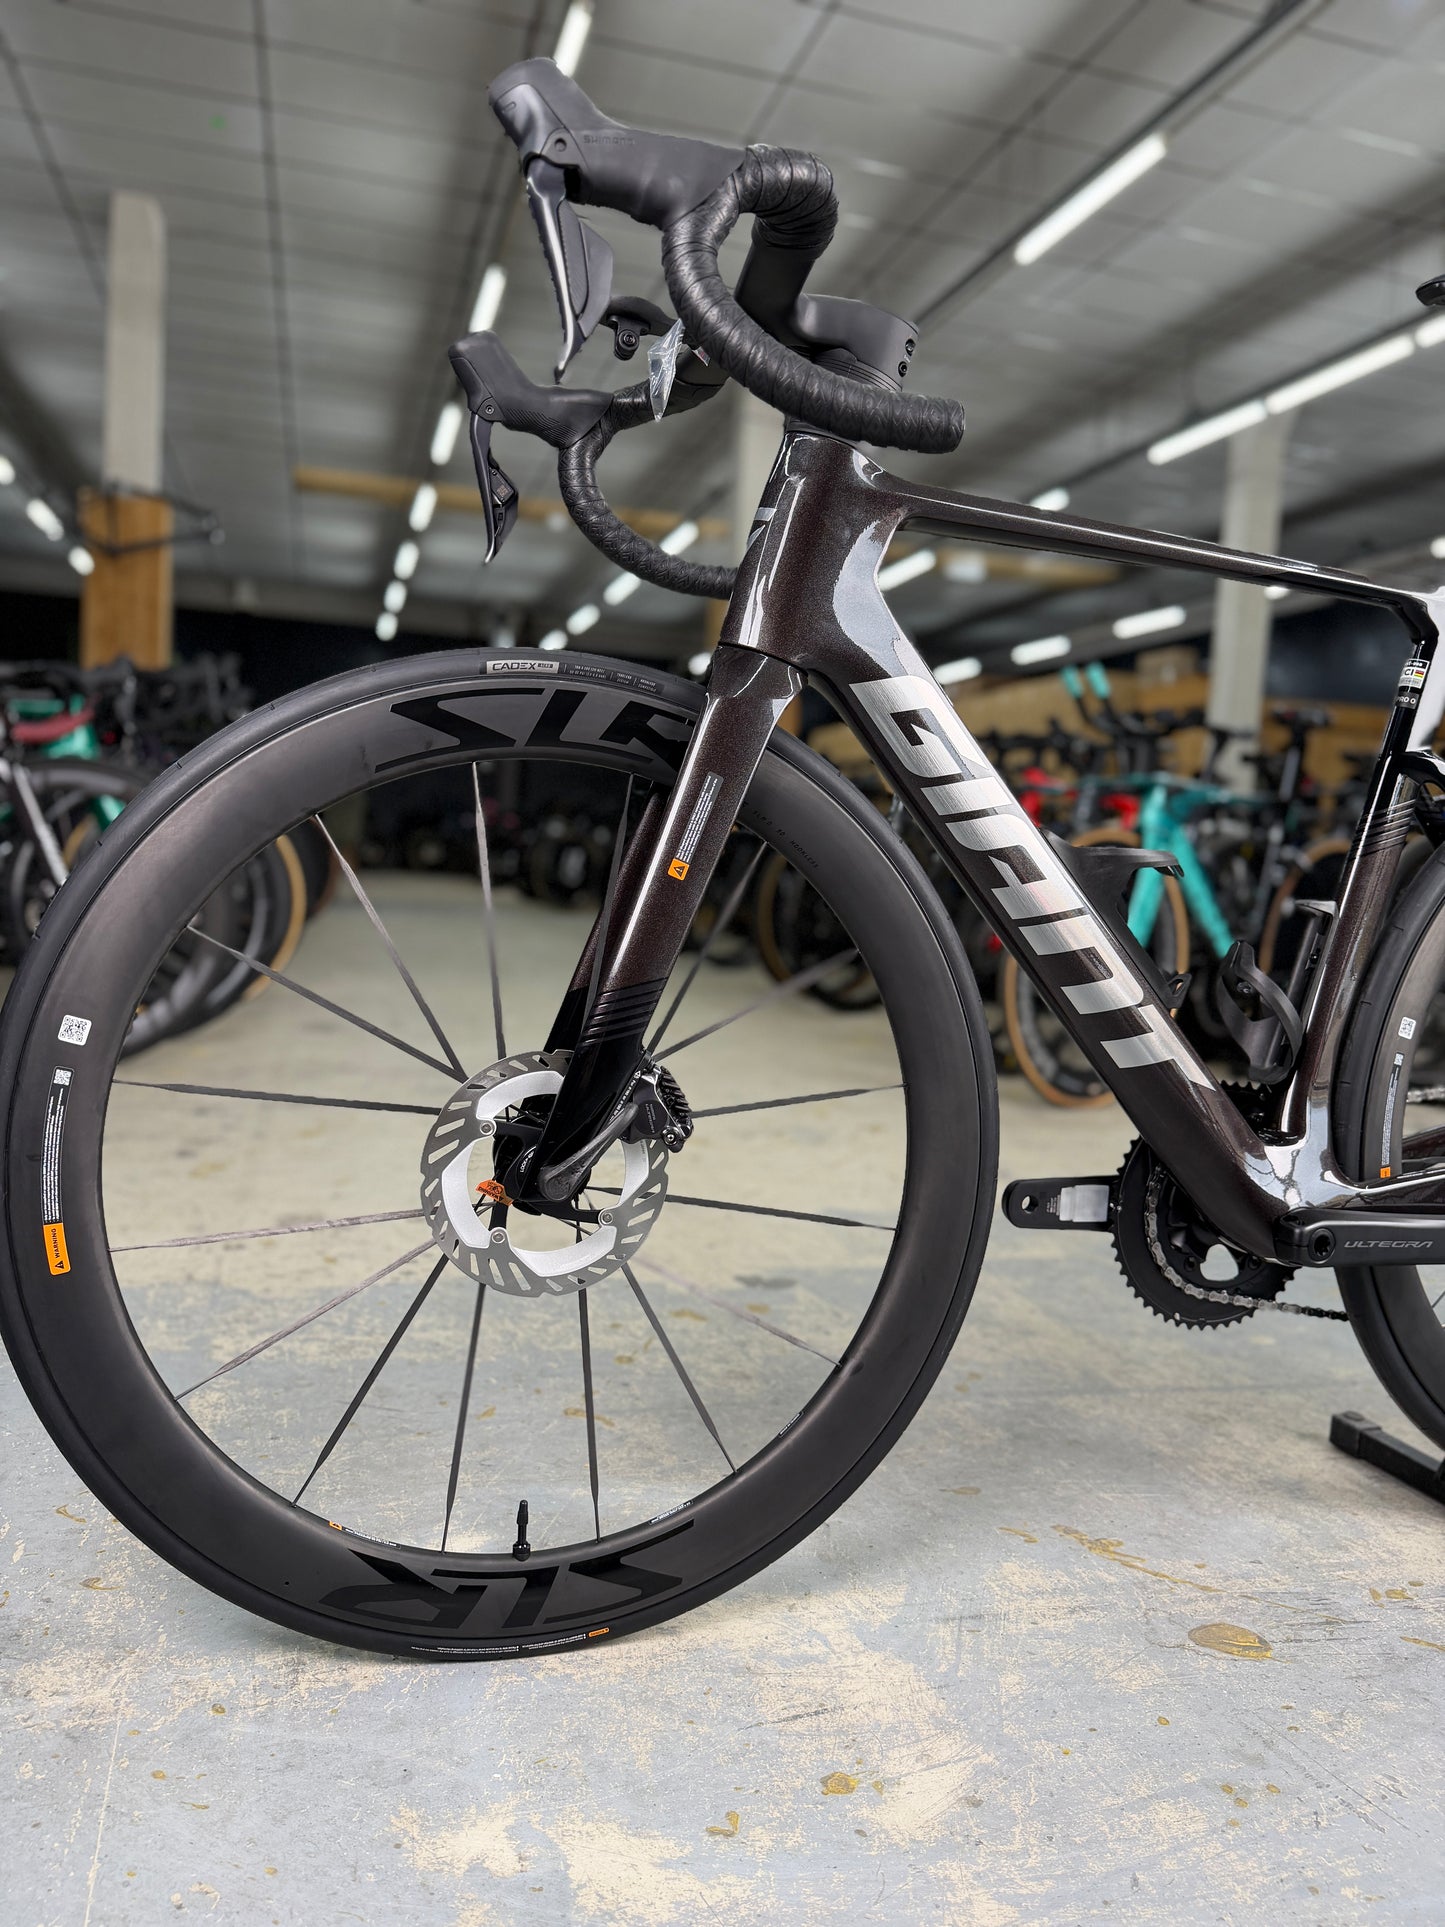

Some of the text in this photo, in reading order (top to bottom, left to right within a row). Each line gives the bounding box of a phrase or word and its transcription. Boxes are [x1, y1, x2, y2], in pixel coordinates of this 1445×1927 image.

[492, 662, 537, 671] CADEX
[849, 675, 1216, 1091] GIANT
[50, 1227, 61, 1259] WARNING
[1344, 1240, 1434, 1249] ULTEGRA
